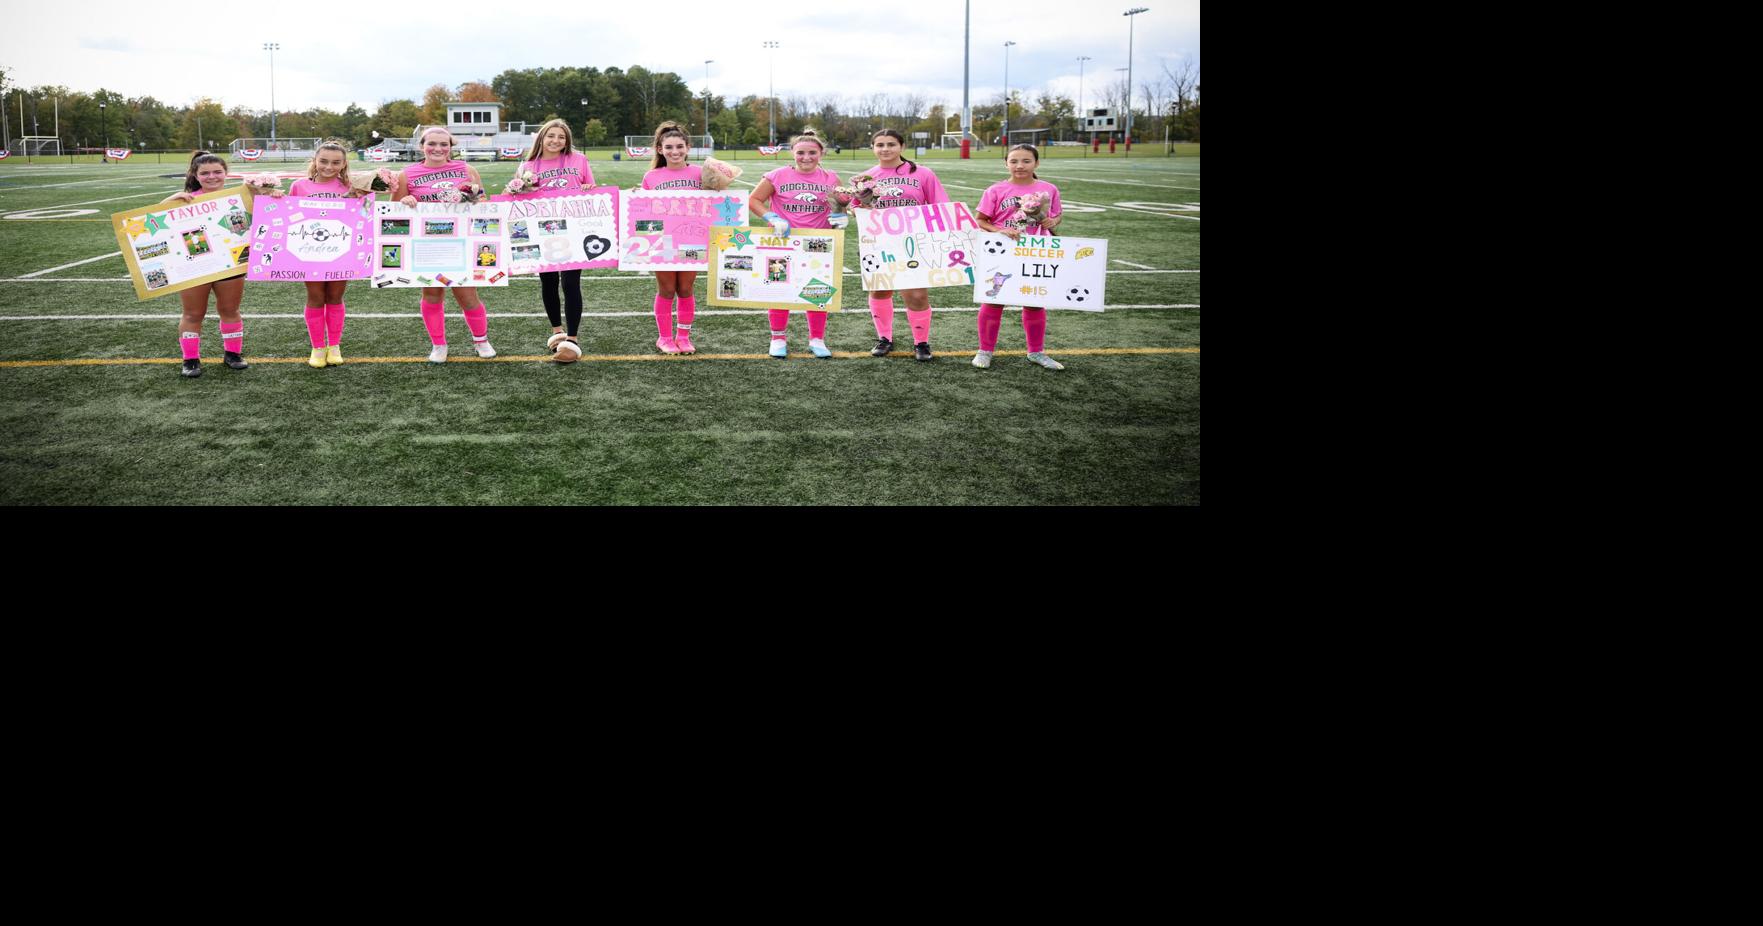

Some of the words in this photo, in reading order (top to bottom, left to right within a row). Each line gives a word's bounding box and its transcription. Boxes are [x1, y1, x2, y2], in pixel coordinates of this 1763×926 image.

[413, 171, 466, 187] RIDGEDALE
[537, 167, 579, 179] DGEDALE
[878, 177, 919, 188] GEDALE
[168, 201, 219, 220] TAYLOR
[480, 203, 499, 214] #3
[508, 199, 610, 220] ADRIANNA
[866, 202, 979, 236] SOPHIA
[299, 243, 340, 254] Andrea
[759, 236, 791, 248] NAT
[544, 237, 573, 262] 8
[622, 235, 679, 264] 24
[1014, 247, 1064, 258] SOCCER
[882, 251, 896, 263] In
[270, 271, 306, 280] PASSION
[325, 270, 355, 280] FUELED
[1021, 263, 1059, 278] LILY
[862, 273, 897, 290] WAY
